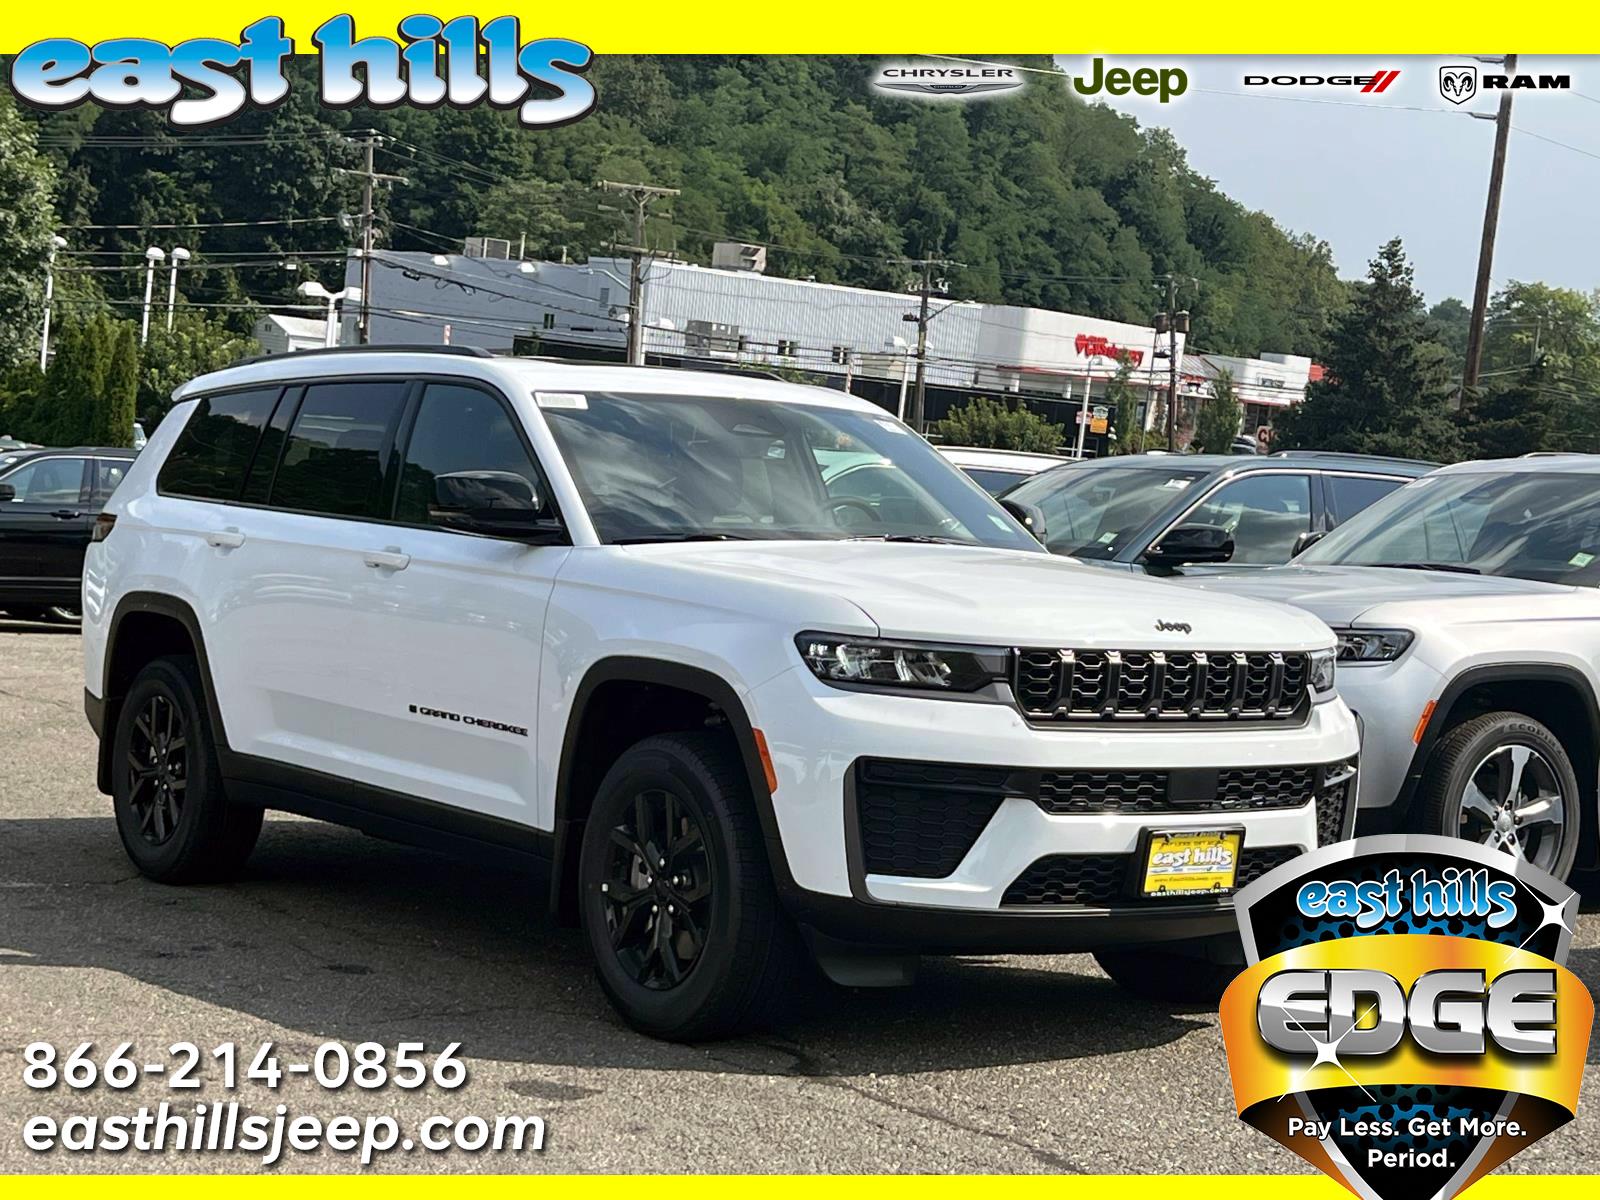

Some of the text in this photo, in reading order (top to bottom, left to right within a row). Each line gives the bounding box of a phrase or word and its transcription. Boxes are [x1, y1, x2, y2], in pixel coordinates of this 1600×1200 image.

[1155, 618, 1192, 634] Jeep
[419, 706, 529, 737] GRAND CHEROKEE
[1152, 843, 1233, 868] east hills
